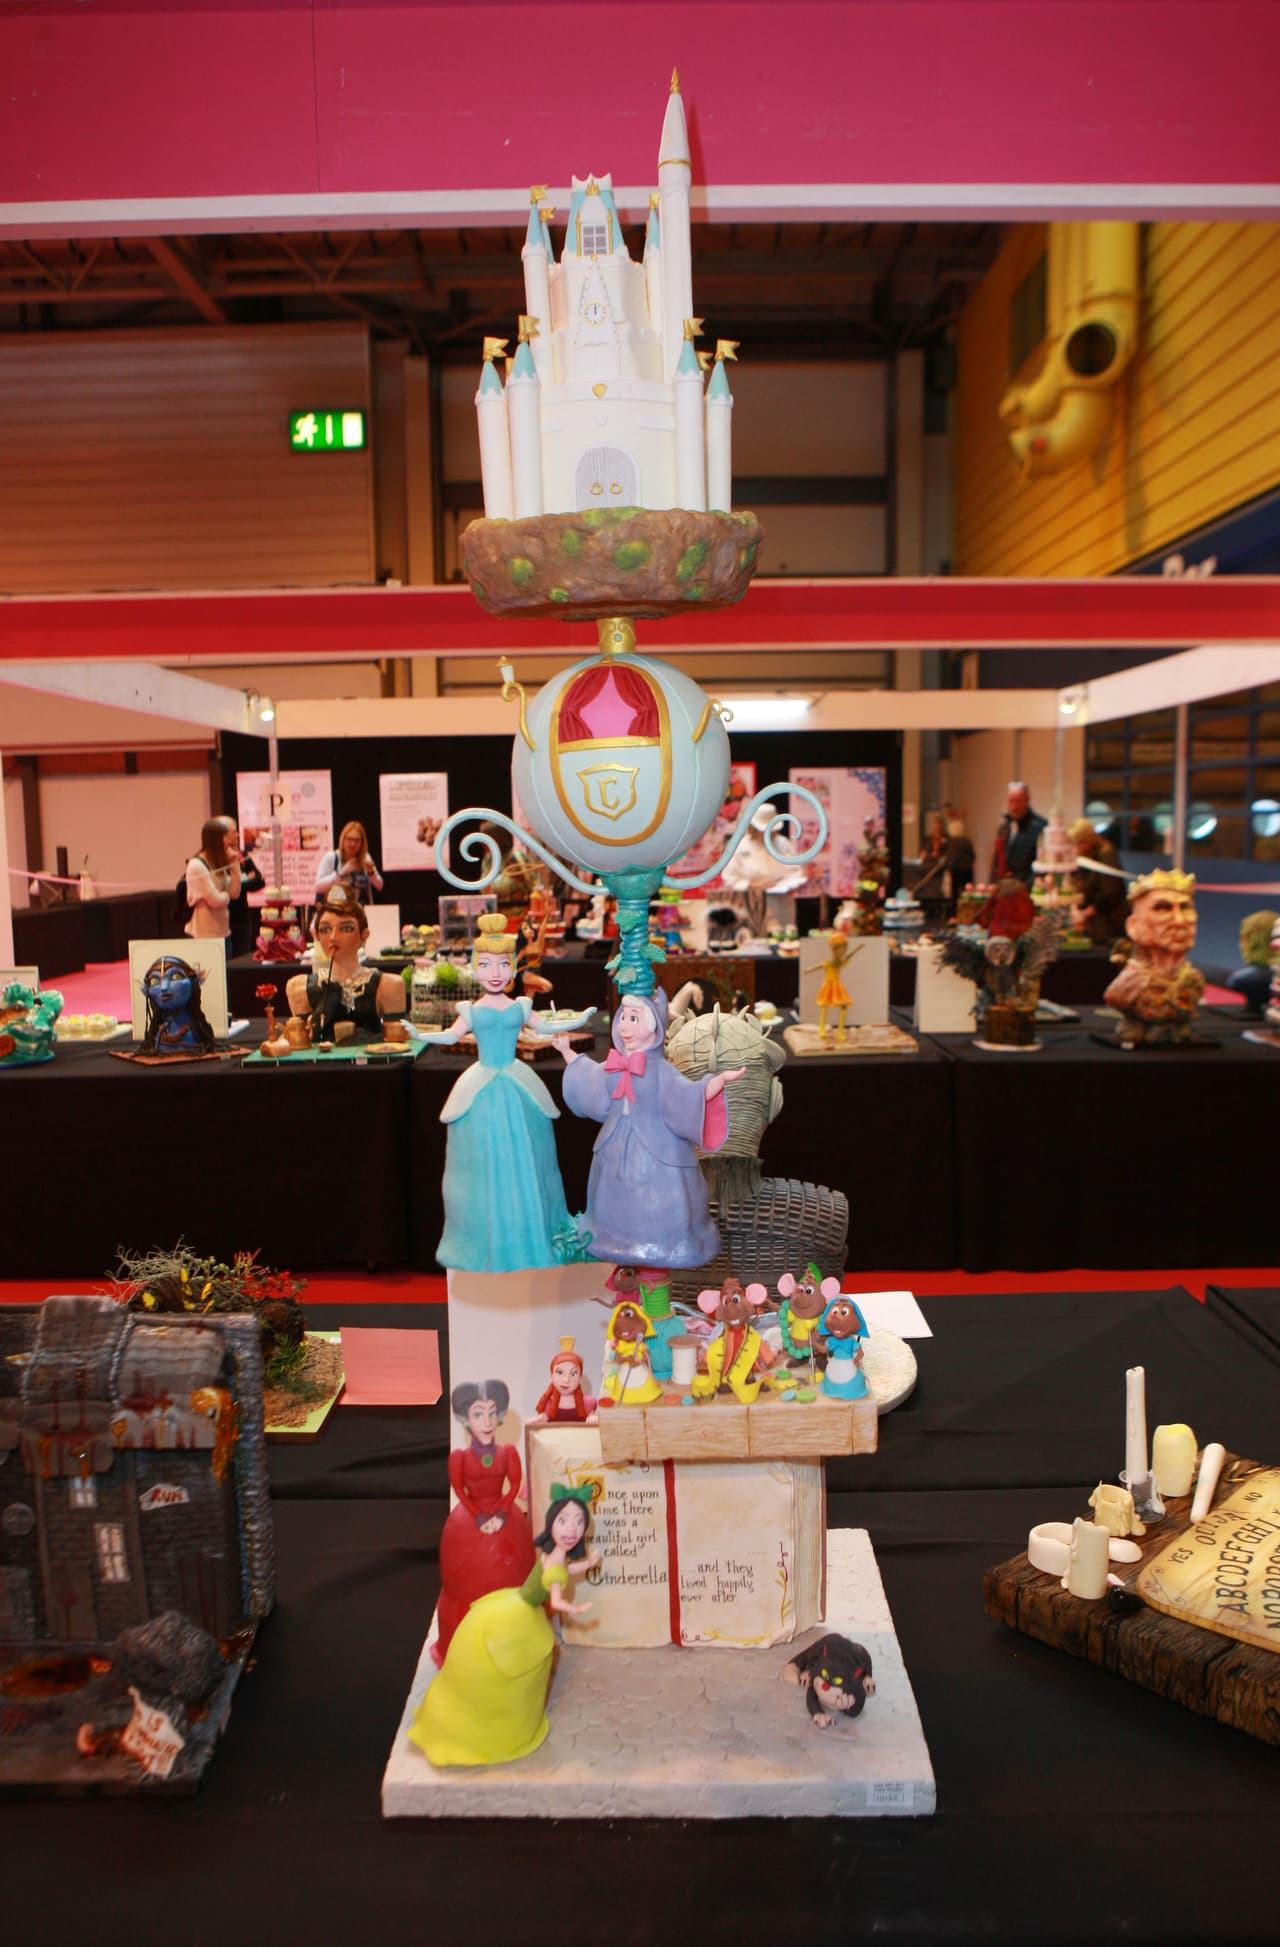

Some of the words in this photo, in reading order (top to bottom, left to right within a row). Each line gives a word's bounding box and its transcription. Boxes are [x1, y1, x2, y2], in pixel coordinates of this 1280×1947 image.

[632, 1489, 659, 1503] upon
[623, 1500, 653, 1515] there
[603, 1519, 627, 1528] was
[632, 1519, 639, 1527] a
[636, 1528, 657, 1549] girl
[603, 1542, 638, 1557] called
[1168, 1547, 1194, 1564] YES
[585, 1564, 668, 1586] Cinderella
[697, 1558, 719, 1574] and
[726, 1559, 754, 1578] they
[680, 1574, 707, 1590] lived
[716, 1575, 755, 1594] happily
[680, 1594, 702, 1603] ever
[711, 1589, 736, 1604] after
